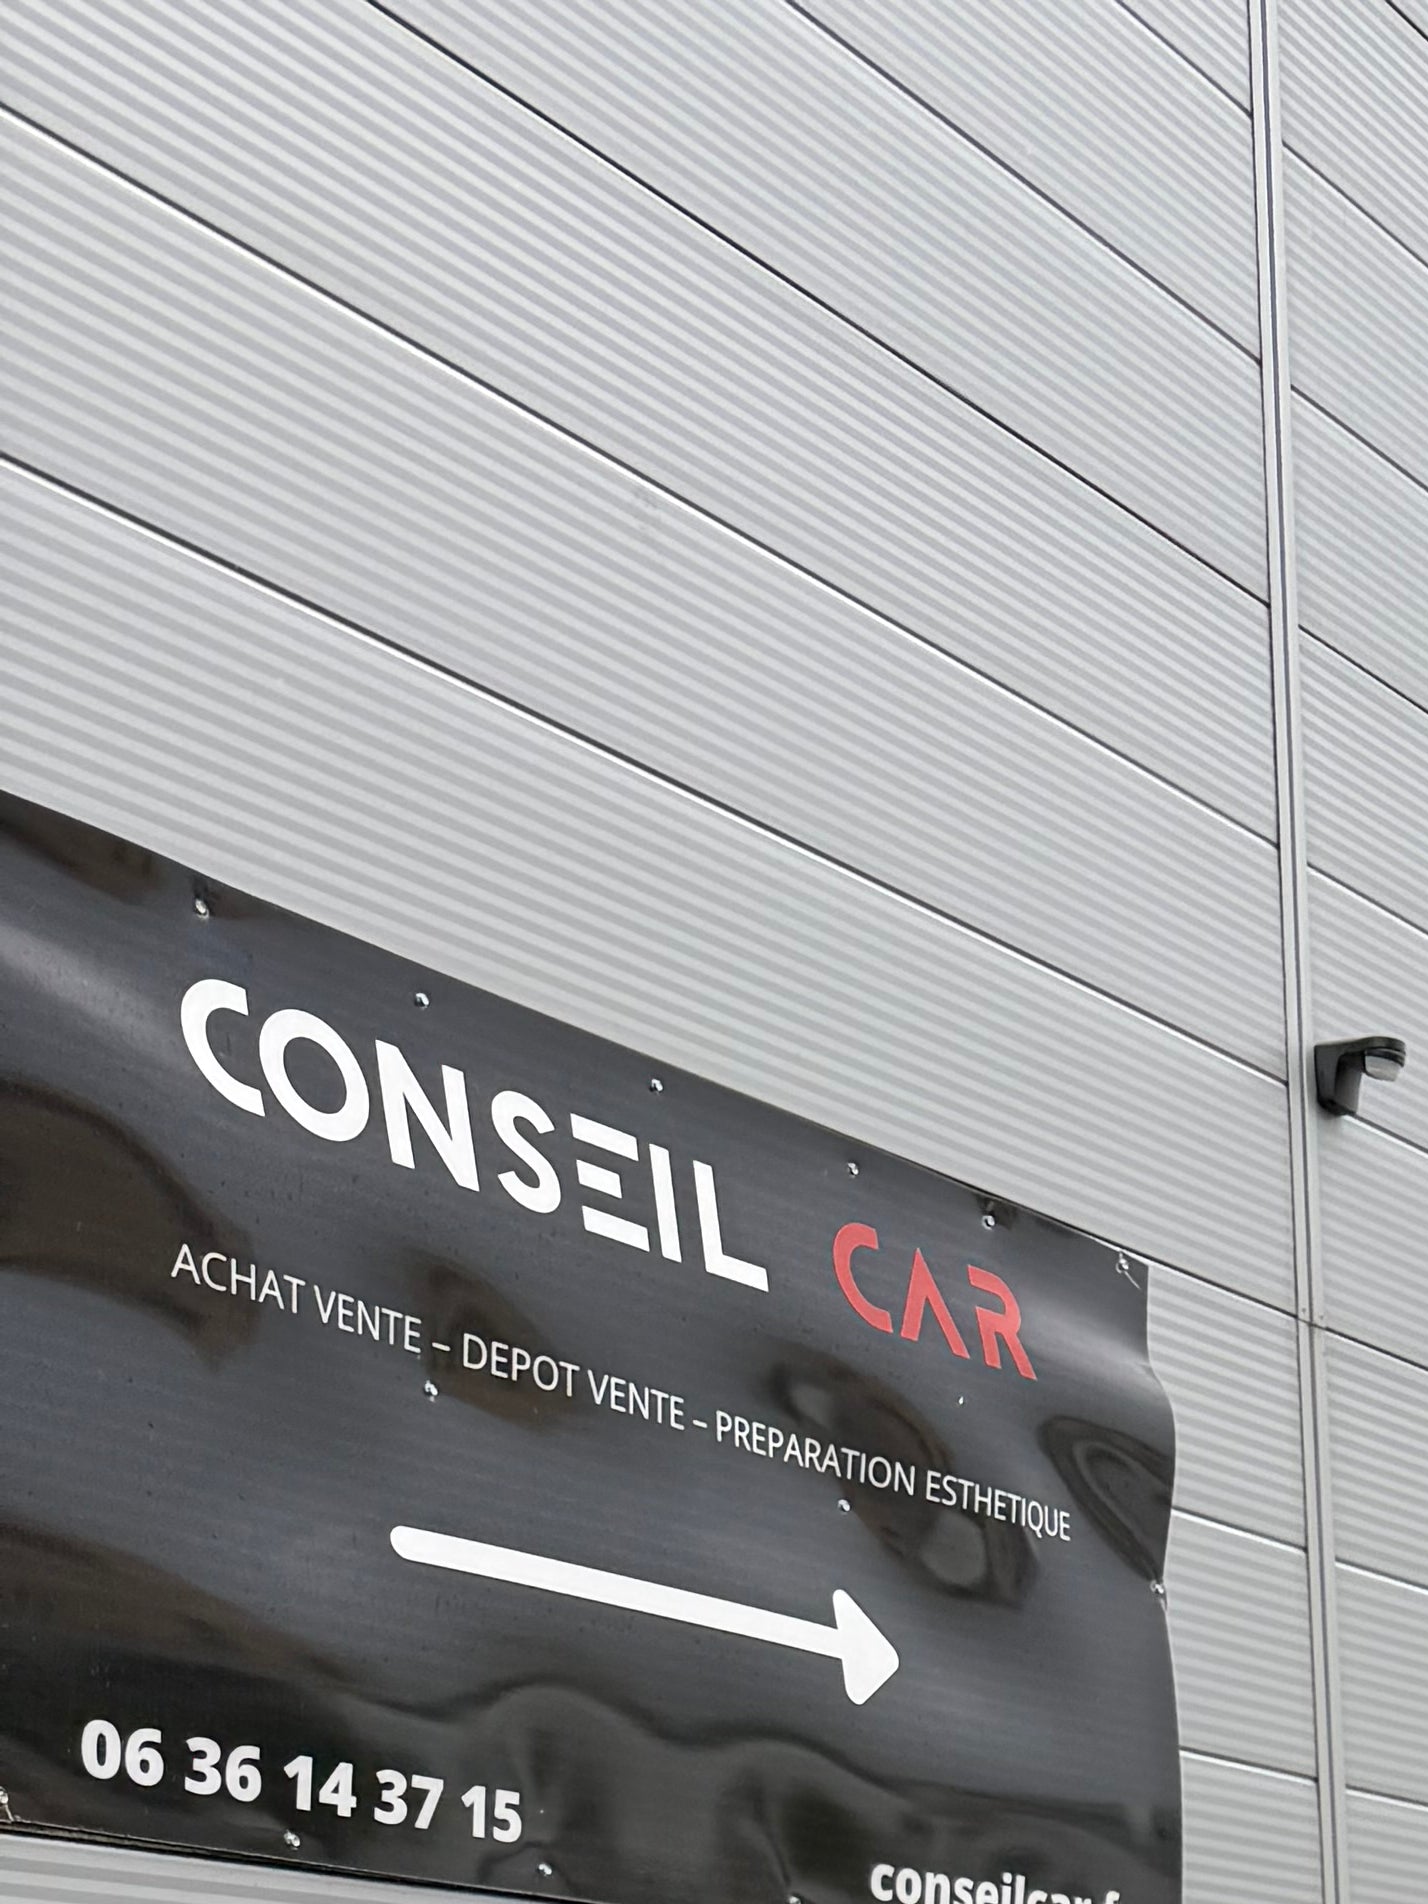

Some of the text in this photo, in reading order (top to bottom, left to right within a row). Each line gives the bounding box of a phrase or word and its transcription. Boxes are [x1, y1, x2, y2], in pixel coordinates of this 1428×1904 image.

[180, 977, 1037, 1381] CONSEIL CAR
[170, 1243, 305, 1314] ACHAT
[313, 1284, 422, 1354] VENTE
[462, 1332, 581, 1397] DEPOT
[588, 1369, 685, 1431] VENTE
[715, 1409, 916, 1496] PREPARATION
[925, 1469, 1072, 1542] ESTHETIQUE
[81, 1719, 522, 1843] 06 36 14 37 15
